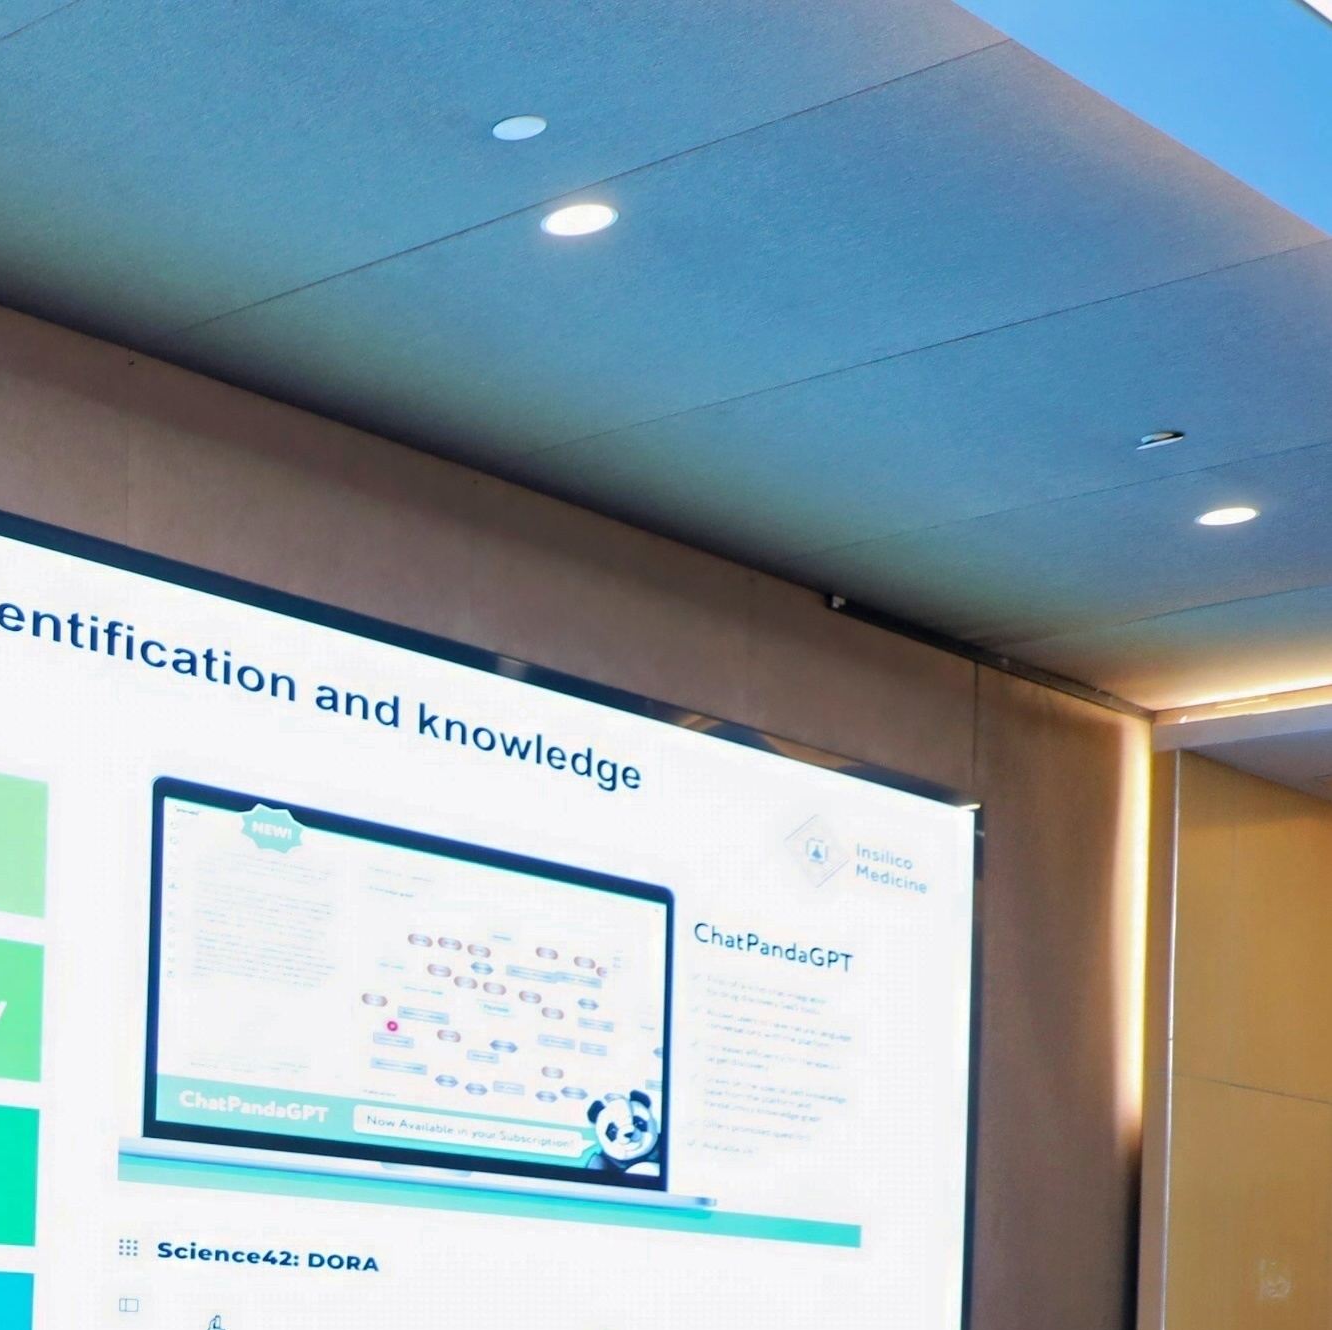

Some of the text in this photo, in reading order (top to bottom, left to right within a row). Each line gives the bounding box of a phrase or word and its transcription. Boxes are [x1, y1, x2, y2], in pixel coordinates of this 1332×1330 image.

[315, 685, 400, 728] and
[418, 702, 641, 792] knowledge
[251, 821, 292, 839] NEW!
[855, 843, 914, 871] Insilico
[855, 863, 927, 894] Medicine
[693, 921, 853, 972] ChatPandaGPT
[177, 1089, 329, 1122] ChatPandaGPT
[366, 1114, 395, 1127] Now
[398, 1119, 454, 1134] Available
[157, 1241, 379, 1272] Science42: DORA
